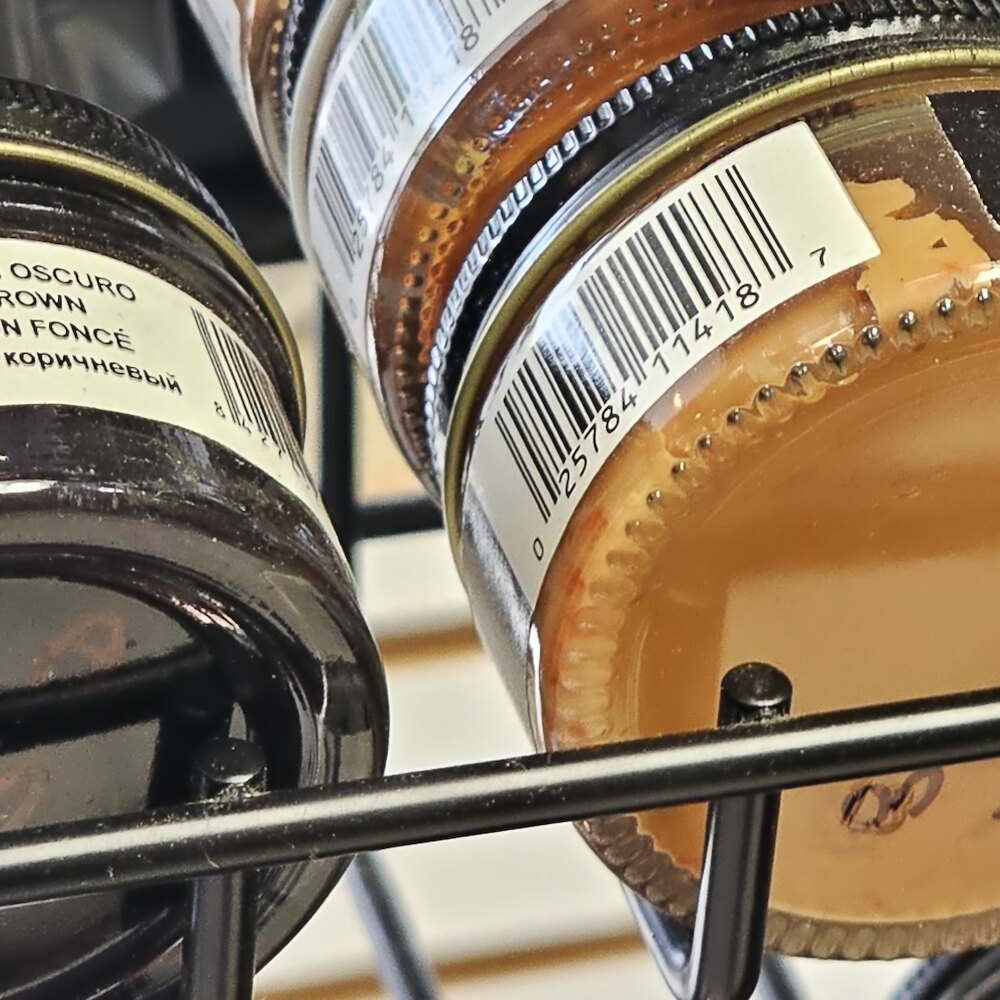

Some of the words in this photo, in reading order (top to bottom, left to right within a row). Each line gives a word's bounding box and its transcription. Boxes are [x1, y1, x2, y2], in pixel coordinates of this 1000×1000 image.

[10, 262, 137, 302] OSCURO
[30, 319, 136, 353] FONCÉ
[4, 351, 183, 396] коричневый
[531, 537, 545, 562] 0
[557, 391, 638, 499] 25784
[652, 283, 760, 375] 11418
[809, 245, 828, 268] 7
